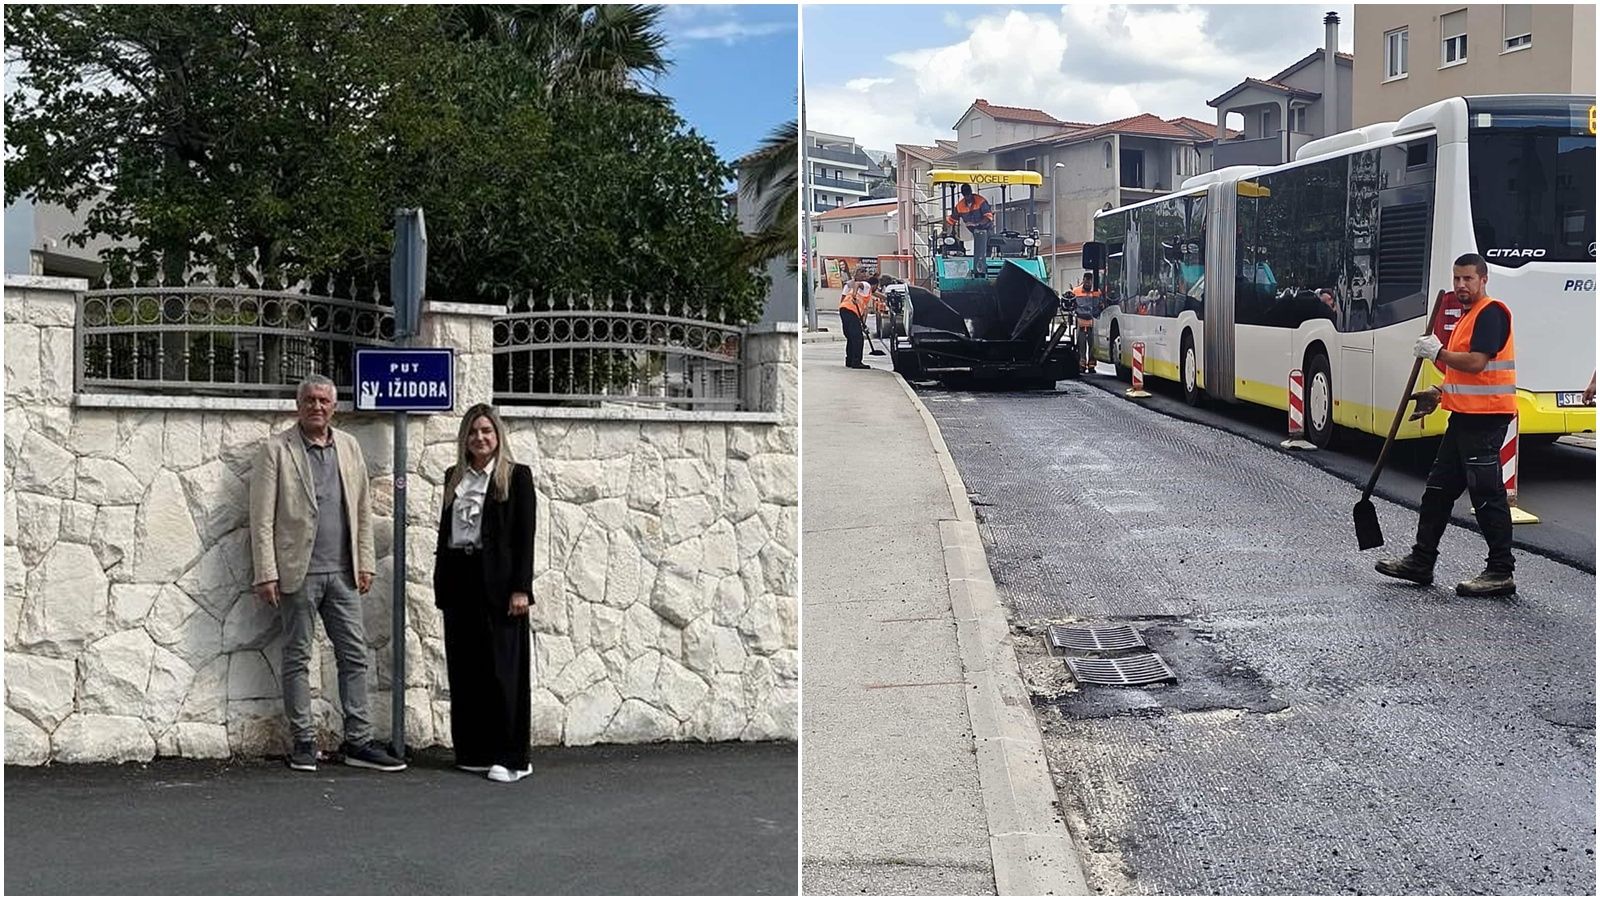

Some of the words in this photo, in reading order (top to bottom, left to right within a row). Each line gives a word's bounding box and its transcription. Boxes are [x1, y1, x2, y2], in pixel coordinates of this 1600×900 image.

[1486, 249, 1546, 257] CITARO
[1564, 279, 1596, 291] PRO
[390, 363, 419, 372] PUT
[361, 381, 383, 397] SV.
[388, 377, 447, 397] IŽIDORA
